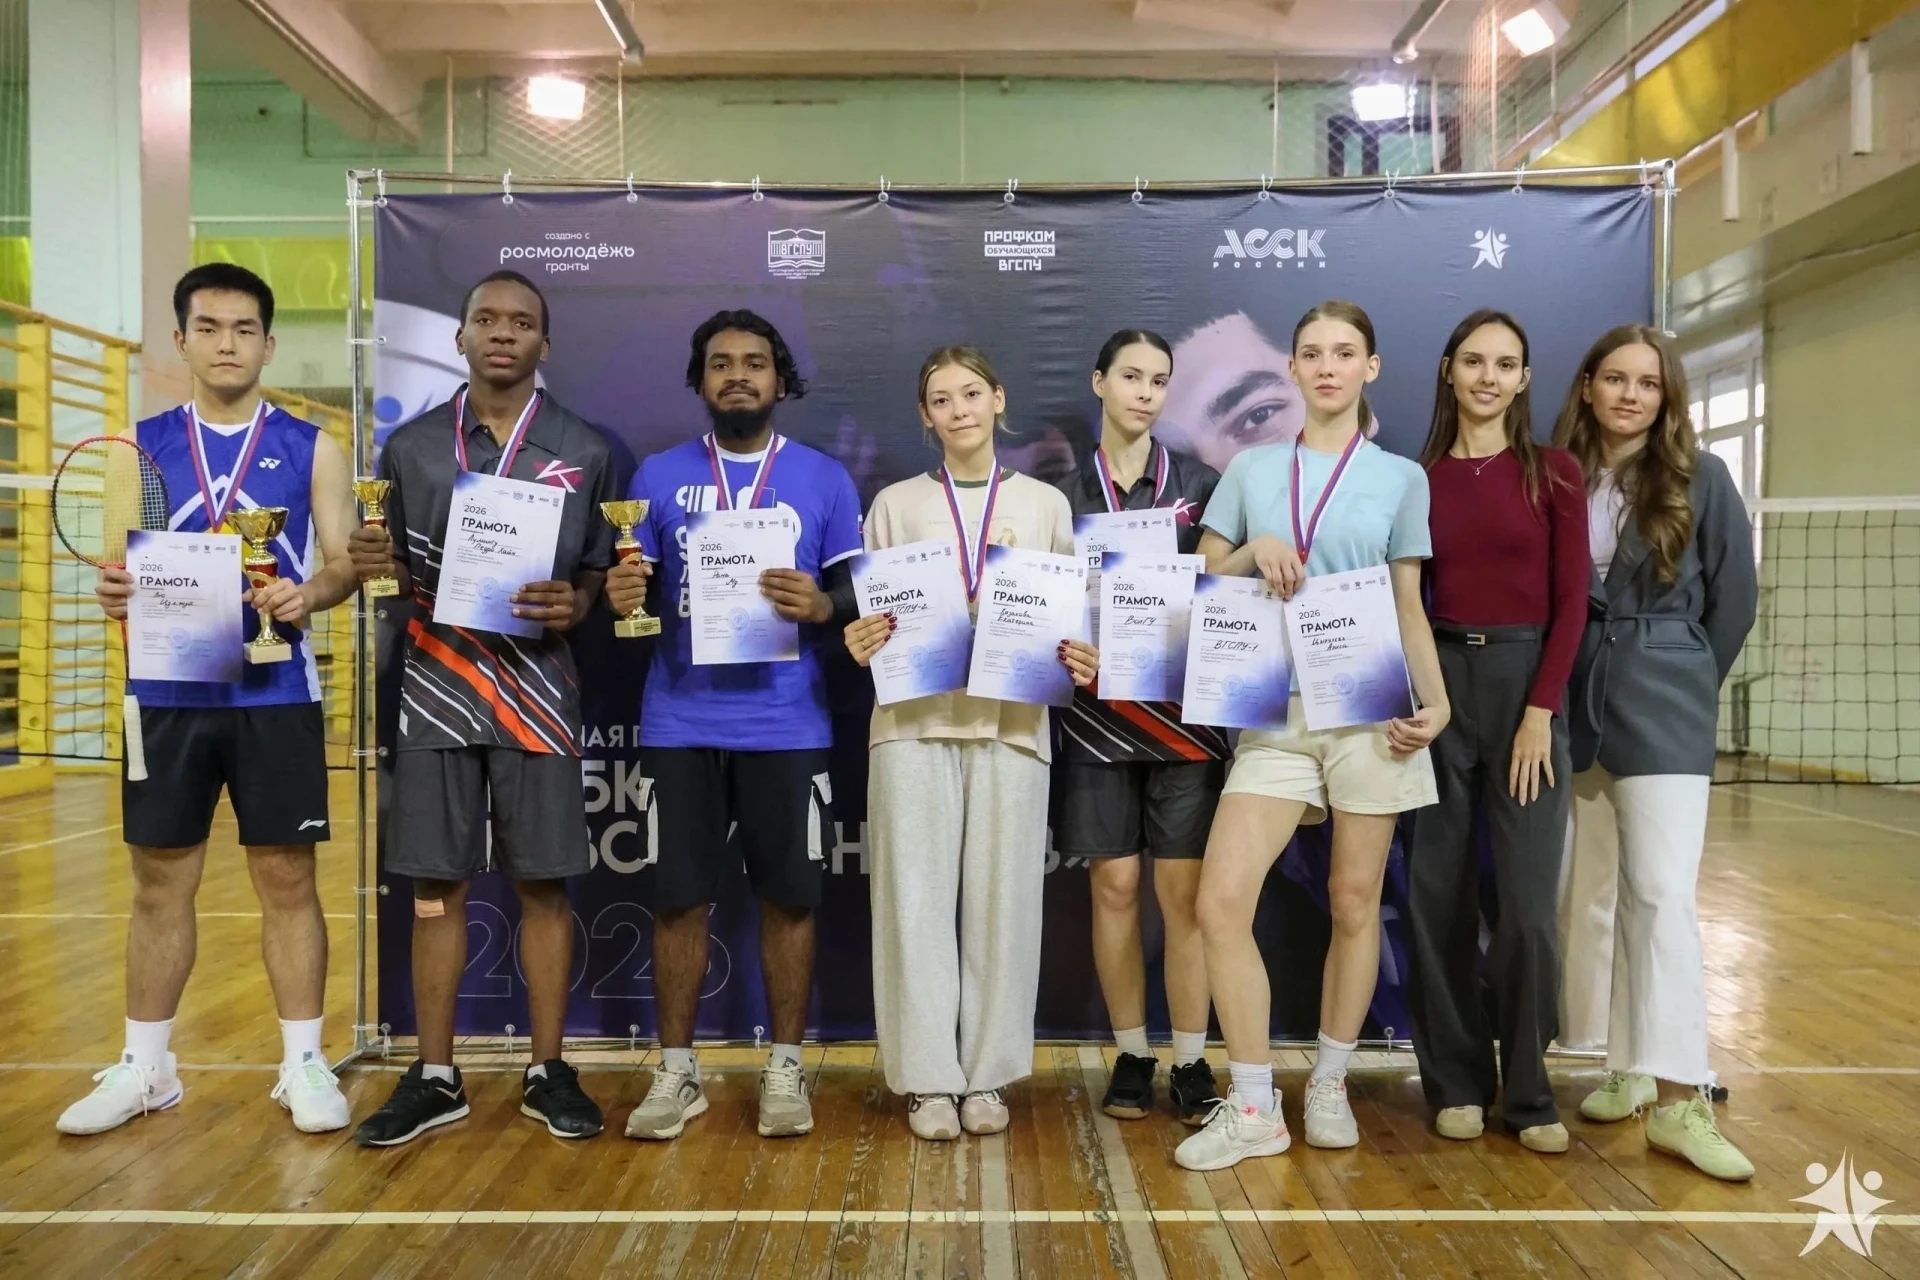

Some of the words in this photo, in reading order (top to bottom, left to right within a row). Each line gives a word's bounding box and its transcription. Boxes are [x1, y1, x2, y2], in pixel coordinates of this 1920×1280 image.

[545, 232, 582, 241] создано
[585, 232, 590, 240] с
[984, 230, 1055, 243] ПРОФКОМ
[781, 243, 812, 255] ВГСПУ
[1213, 228, 1327, 259] АССК
[500, 243, 635, 264] росмолодёжь
[986, 247, 1053, 255] ОБУЧАЮЩИХСЯ
[546, 262, 589, 274] гранты
[998, 259, 1042, 271] ВГСПУ
[1213, 261, 1326, 269] РОССИИ
[464, 504, 487, 515] 2026
[461, 516, 517, 536] ГРАМОТА
[700, 543, 722, 552] 2026
[1087, 543, 1108, 553] 2026
[701, 554, 756, 566] ГРАМОТА
[140, 563, 164, 572] 2026
[140, 576, 199, 588] ГРАМОТА
[867, 582, 889, 593] 2026
[995, 577, 1017, 588] 2026
[1113, 583, 1135, 591] 2026
[870, 588, 925, 608] ГРАМОТА
[993, 590, 1047, 607] ГРАМОТА
[1113, 595, 1166, 607] ГРАМОТА
[1204, 605, 1227, 615] 2026
[1298, 609, 1321, 620] 2026
[1203, 617, 1257, 632] ГРАМОТА
[1301, 616, 1356, 634] ГРАМОТА
